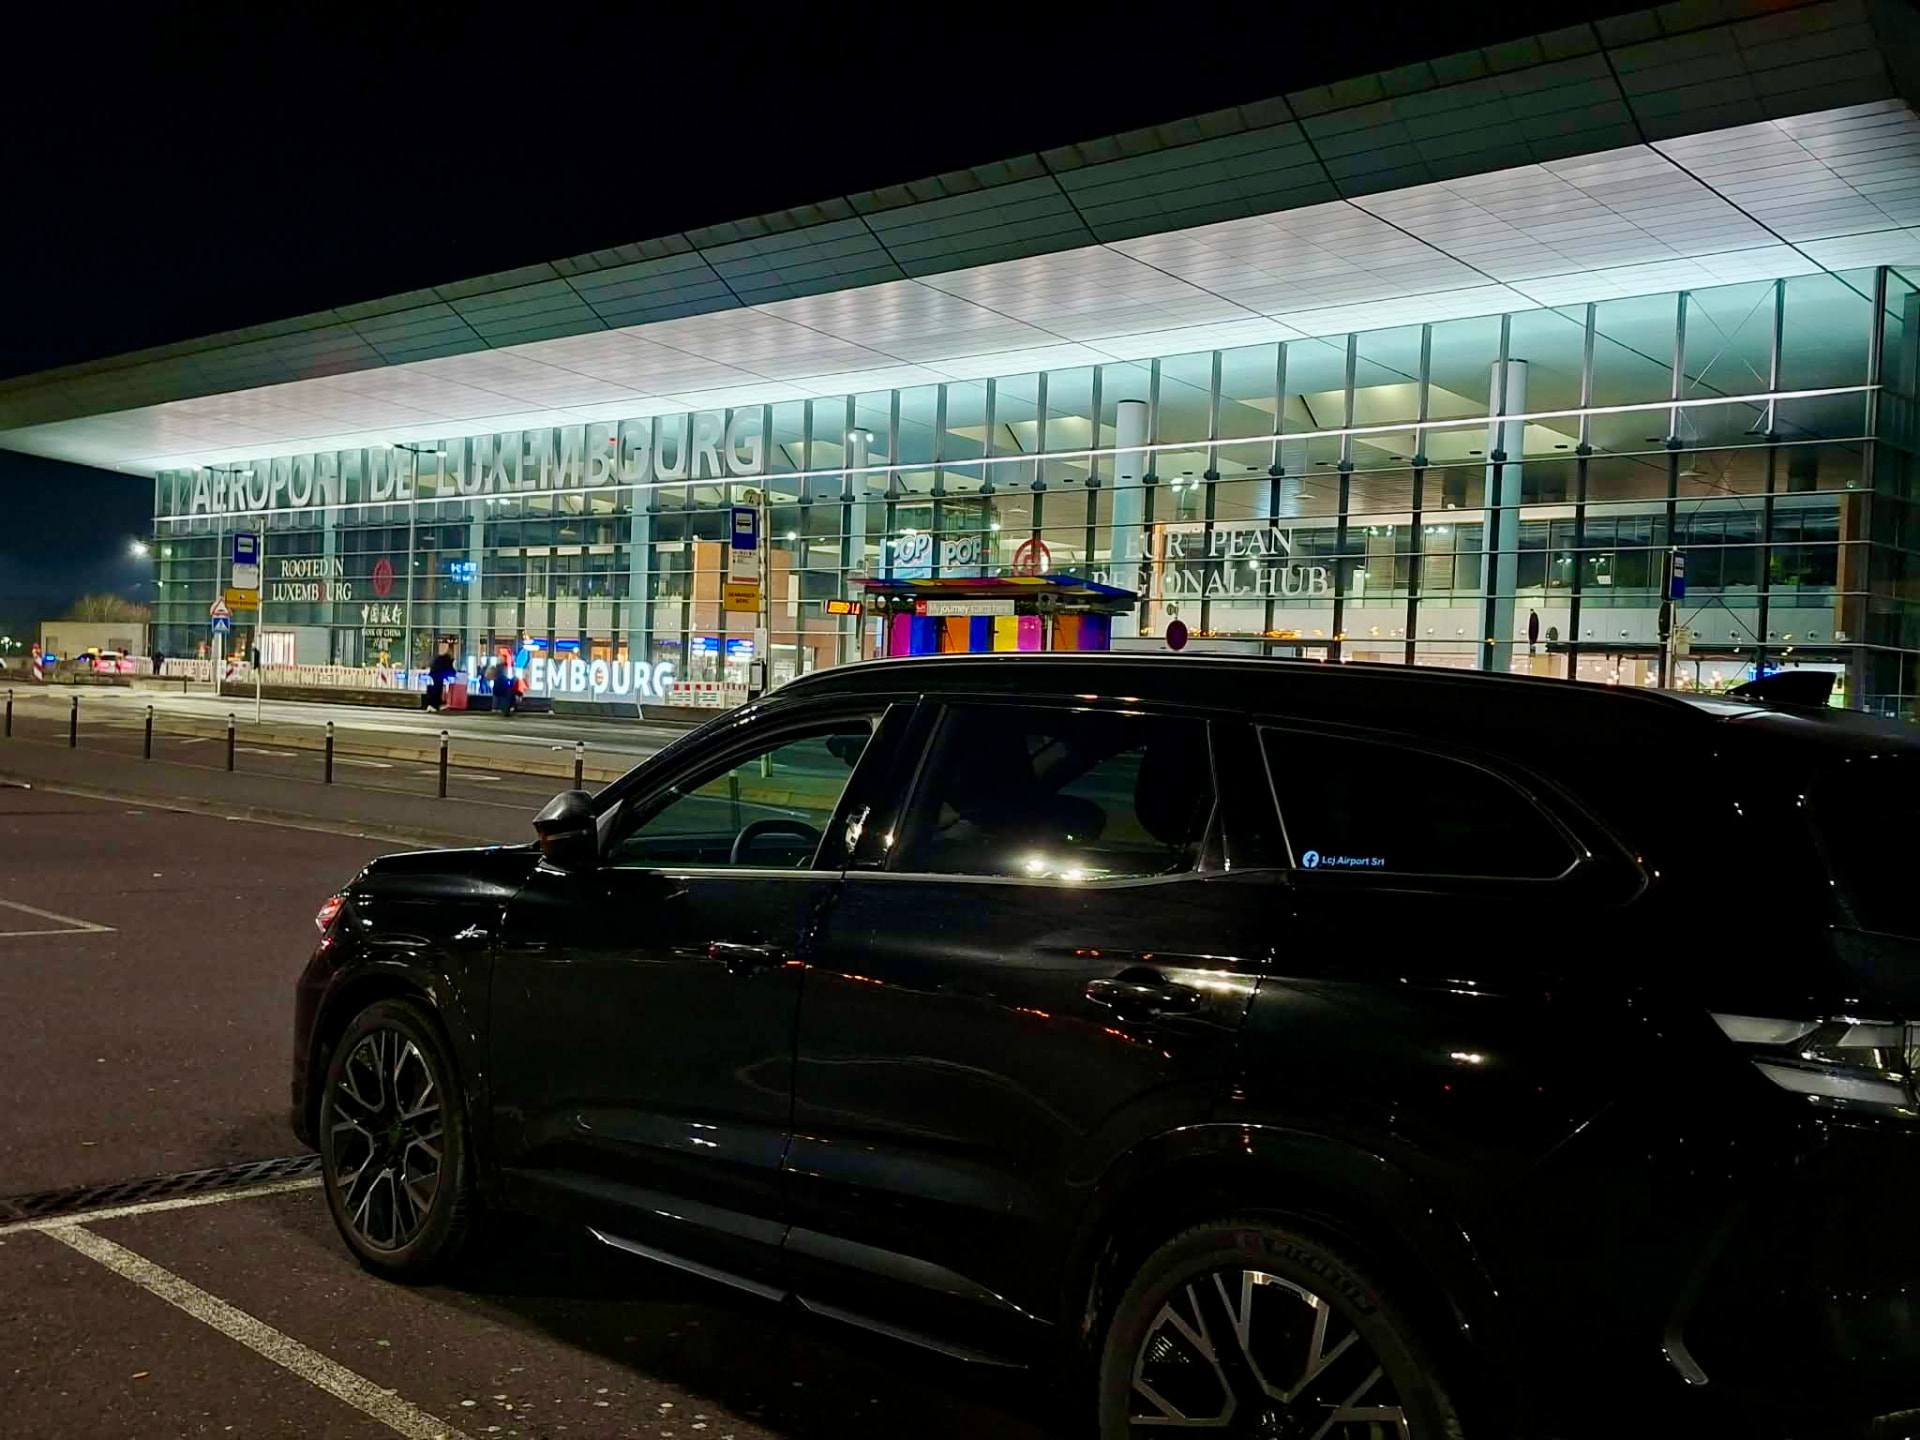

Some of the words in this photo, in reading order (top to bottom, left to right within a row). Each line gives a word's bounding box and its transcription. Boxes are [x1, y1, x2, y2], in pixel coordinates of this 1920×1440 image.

[370, 446, 413, 501] DE
[435, 407, 765, 496] LUXEMBOURG
[1124, 527, 1293, 559] EURPEAN
[281, 559, 329, 578] ROOTED
[331, 558, 344, 577] IN
[1255, 566, 1328, 597] HUB
[940, 604, 969, 615] journey
[384, 628, 401, 637] CHINA
[1337, 856, 1370, 867] Airport
